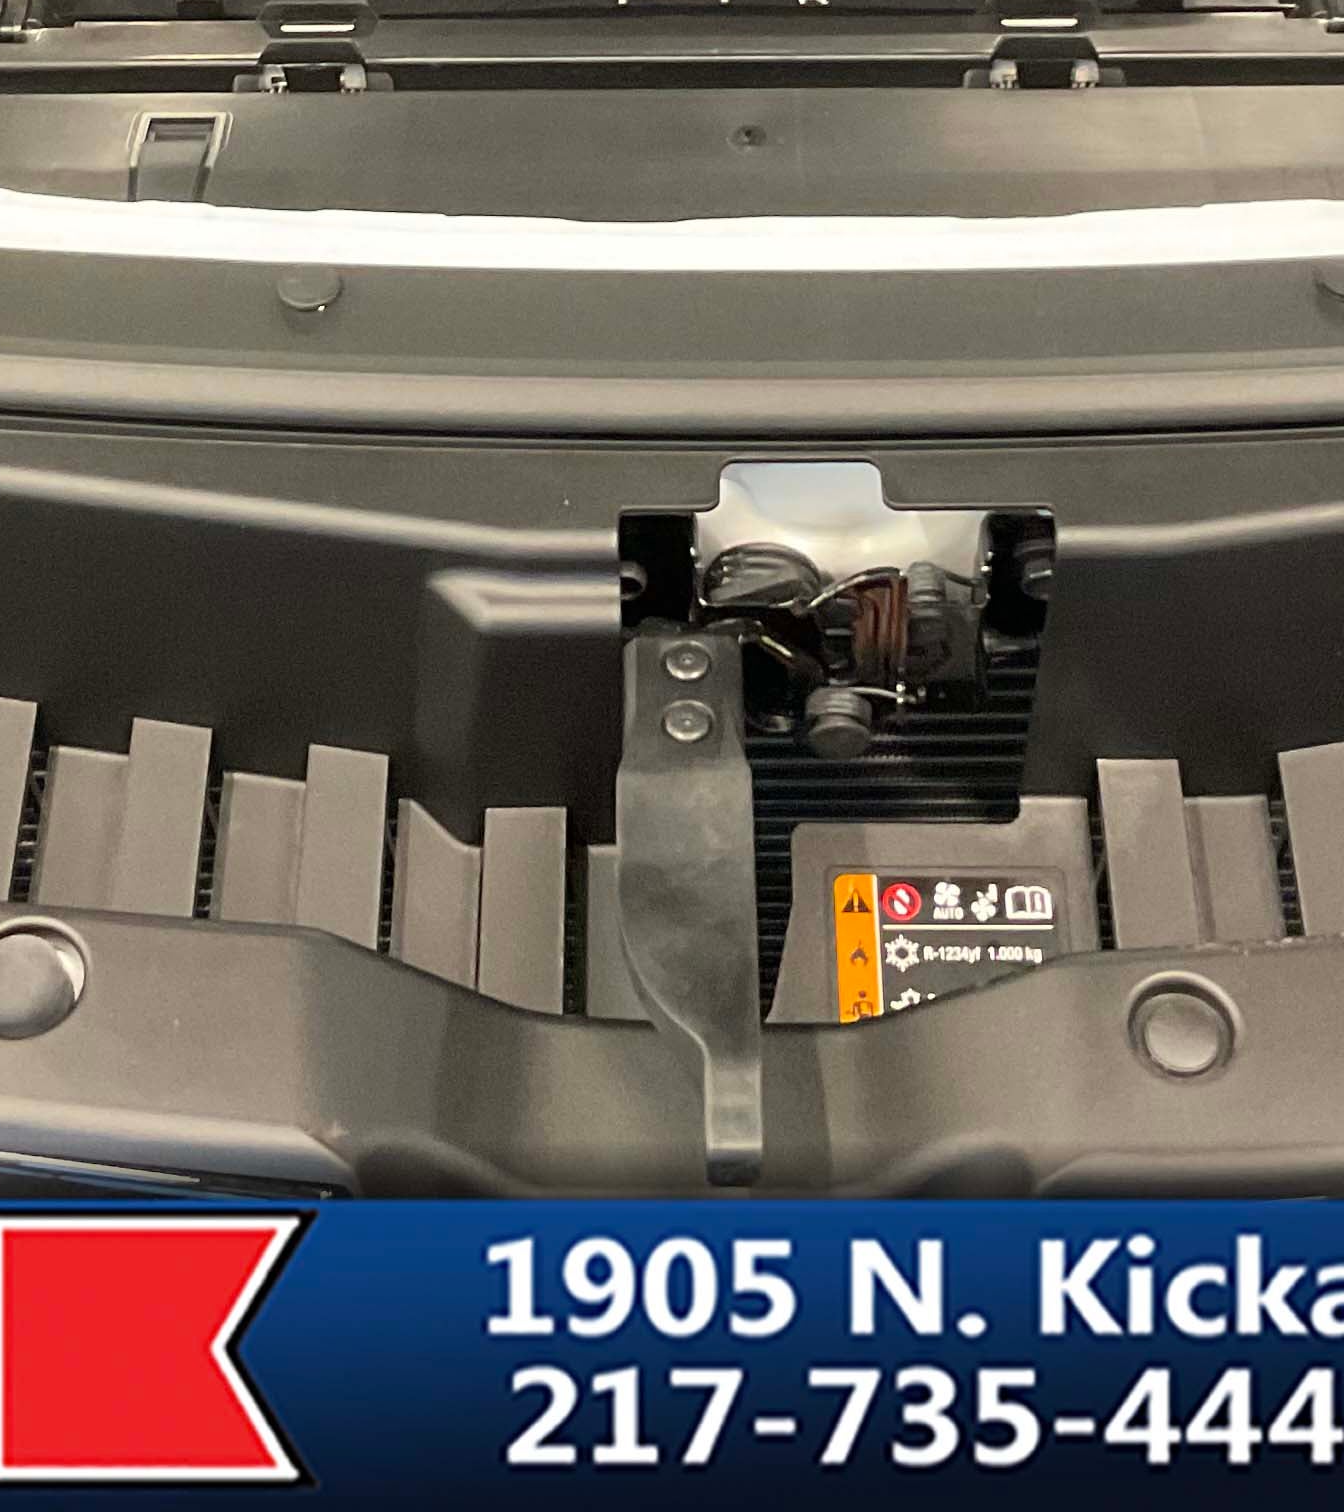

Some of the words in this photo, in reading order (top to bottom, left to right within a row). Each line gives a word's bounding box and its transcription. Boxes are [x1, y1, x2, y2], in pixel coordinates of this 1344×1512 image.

[933, 906, 964, 920] AUTO
[923, 946, 981, 963] R-1234yf
[987, 945, 1023, 961] 1.000
[1025, 946, 1043, 963] kg
